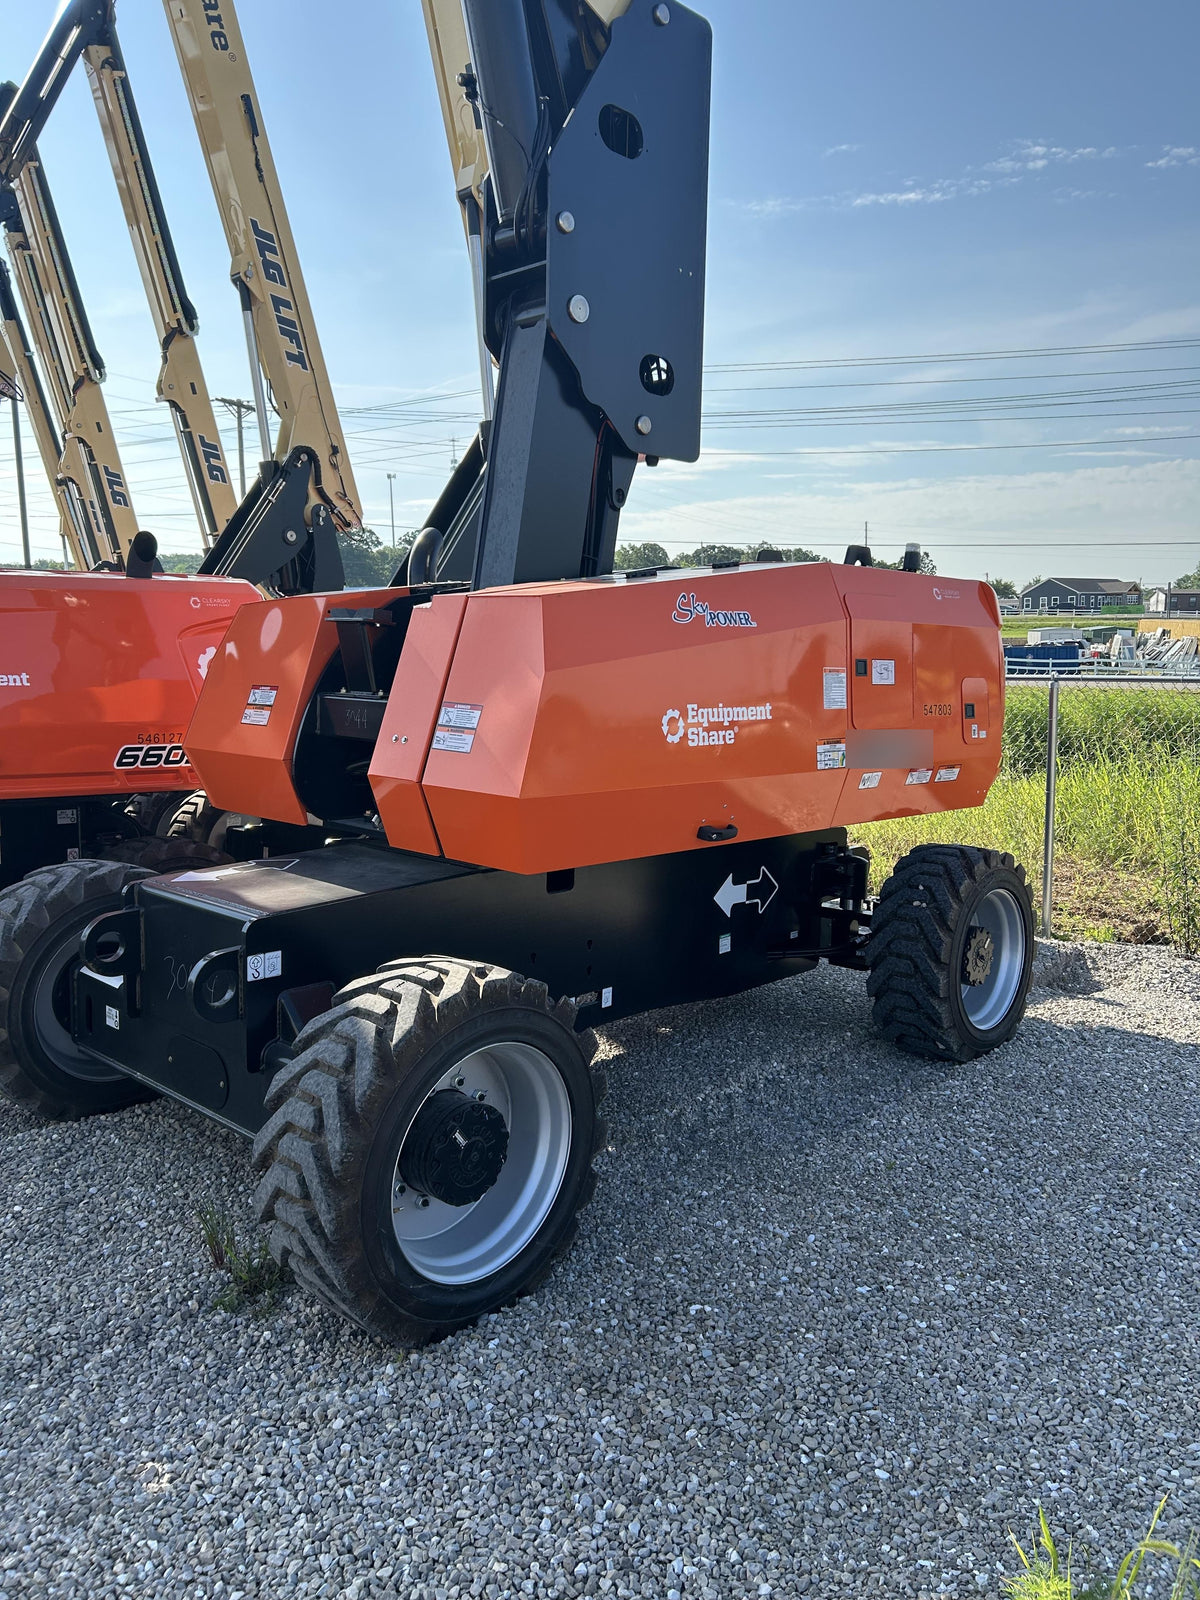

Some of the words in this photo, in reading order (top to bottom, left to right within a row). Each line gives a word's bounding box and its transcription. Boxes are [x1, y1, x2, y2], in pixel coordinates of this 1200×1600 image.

[250, 217, 287, 288] JLG
[269, 293, 310, 373] LIFT
[198, 434, 229, 485] JLG
[102, 464, 130, 508] JLG
[0, 672, 31, 686] ent
[686, 702, 773, 727] Equipment
[923, 704, 952, 716] 547803
[137, 733, 183, 745] 546127
[114, 744, 191, 769] 660
